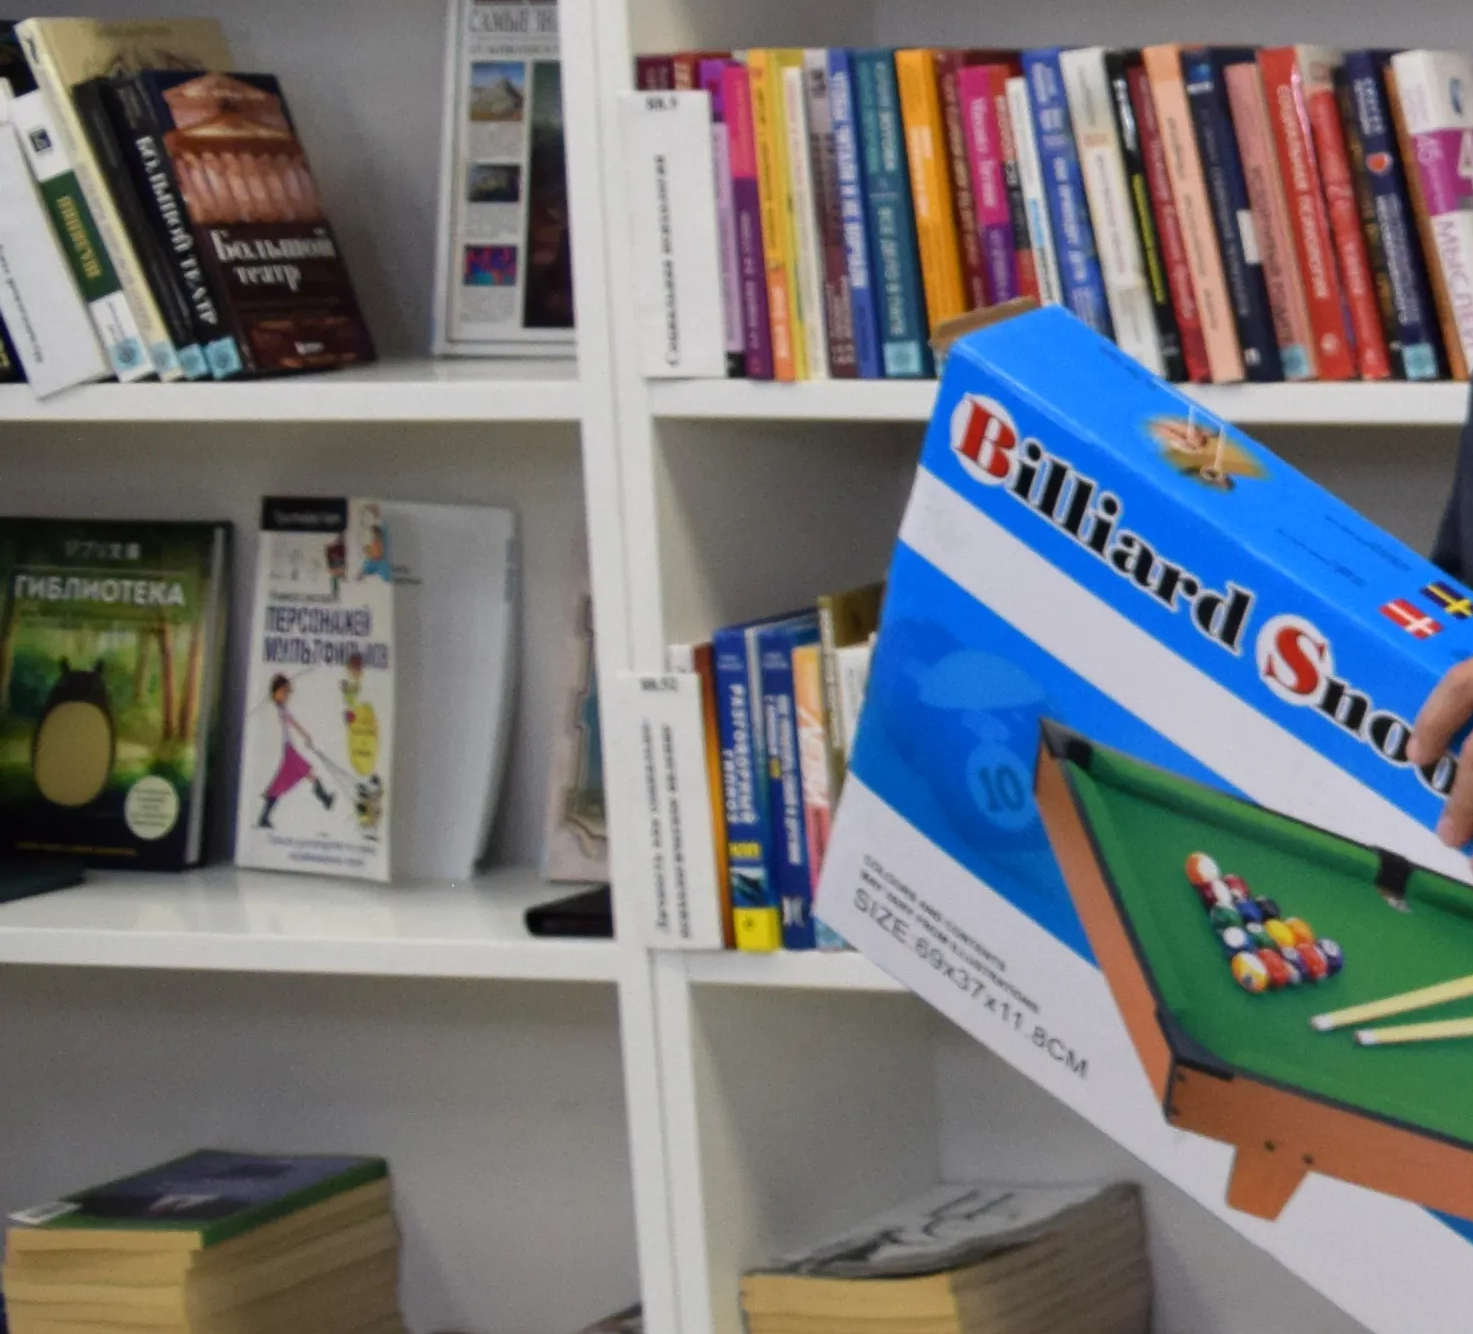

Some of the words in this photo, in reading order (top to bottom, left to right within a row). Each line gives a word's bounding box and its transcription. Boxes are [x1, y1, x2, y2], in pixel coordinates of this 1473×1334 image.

[136, 135, 194, 257] БОЛЬШОЙ
[178, 251, 219, 327] ТЕАТР
[210, 226, 336, 264] Большой
[235, 259, 302, 292] театр
[954, 396, 1256, 656] Billiard
[14, 574, 186, 607] ГИБЛИОТЕКА
[265, 604, 372, 636] ПЕРСОНАЖЕЙ
[727, 683, 758, 824] РАЗГОВОРНЫЙ
[722, 750, 738, 825] ГИПНОЗ
